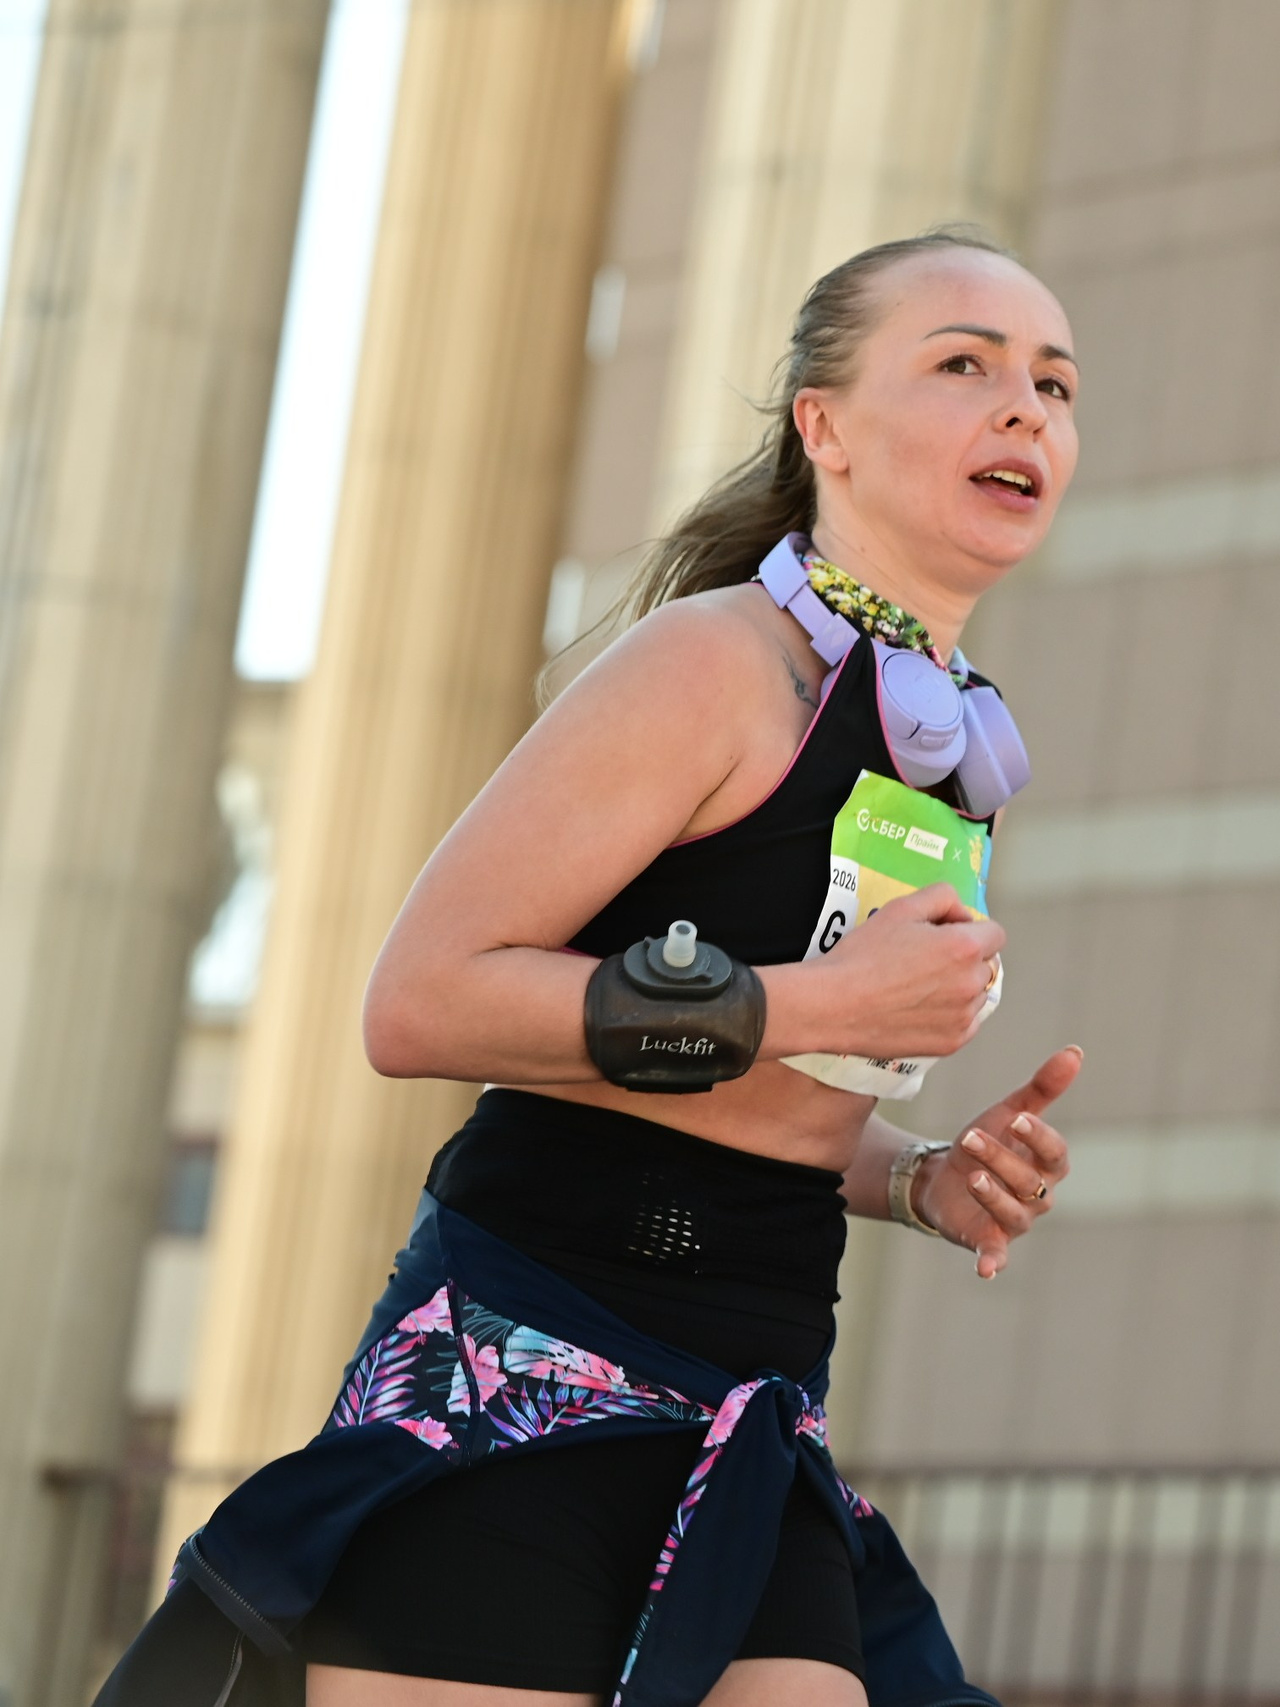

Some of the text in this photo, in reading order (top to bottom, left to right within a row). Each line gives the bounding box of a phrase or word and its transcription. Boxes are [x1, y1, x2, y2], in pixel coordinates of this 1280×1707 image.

[871, 818, 940, 852] СБЕР Прайм
[832, 868, 857, 892] 2026
[818, 910, 847, 955] G
[639, 1035, 717, 1056] Luckfit
